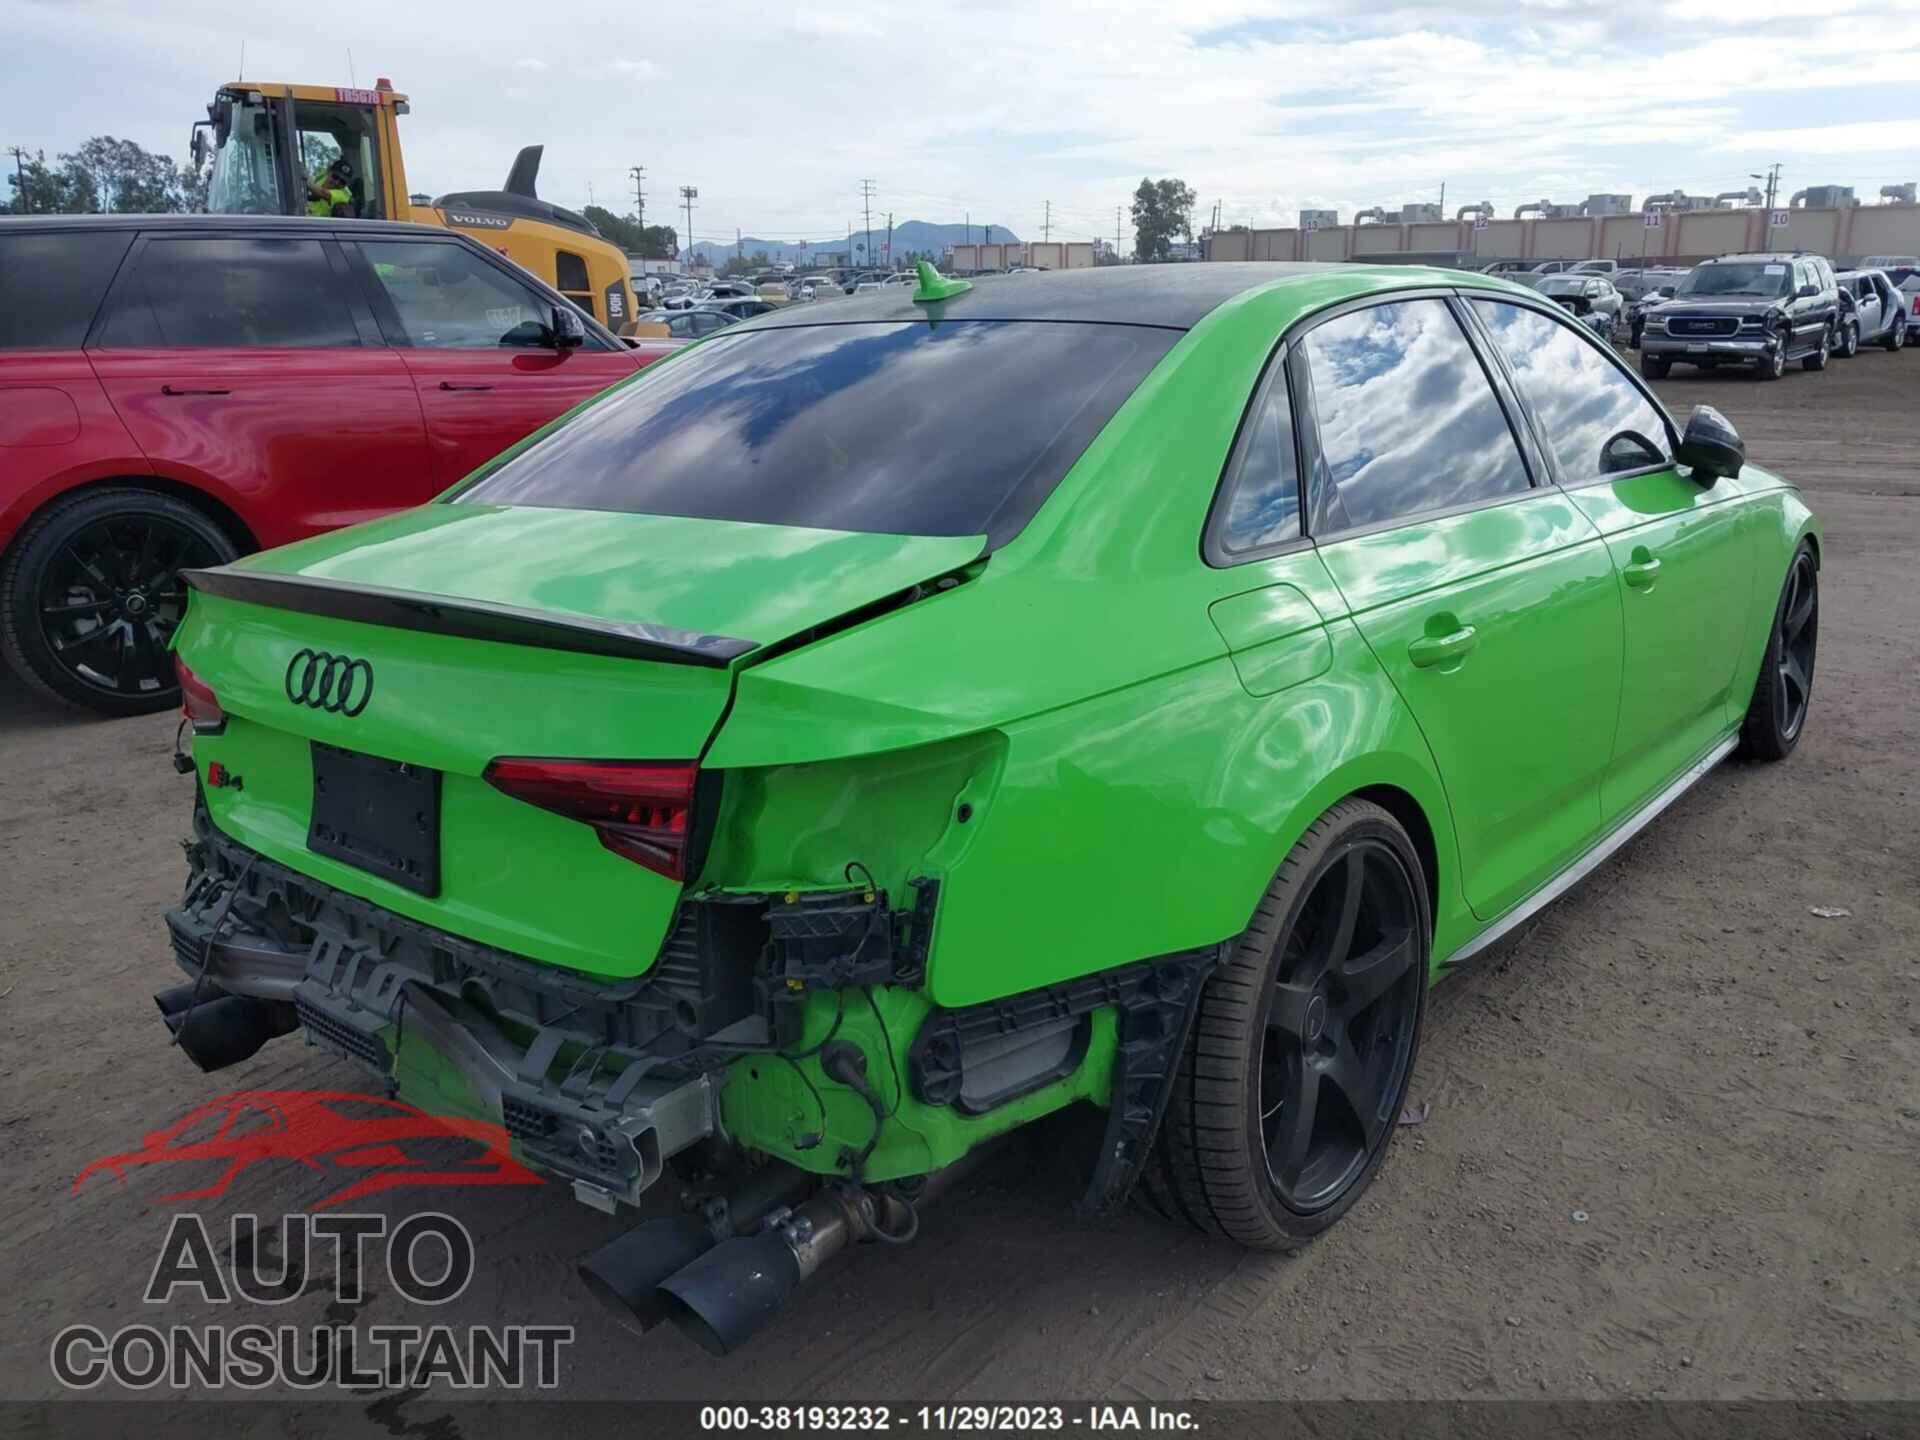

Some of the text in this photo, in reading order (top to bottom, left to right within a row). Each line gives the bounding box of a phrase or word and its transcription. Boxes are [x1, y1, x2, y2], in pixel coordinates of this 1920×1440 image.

[451, 215, 507, 226] VOLVO
[1646, 215, 1660, 226] 11
[1773, 214, 1788, 225] 10
[609, 293, 623, 318] L90H
